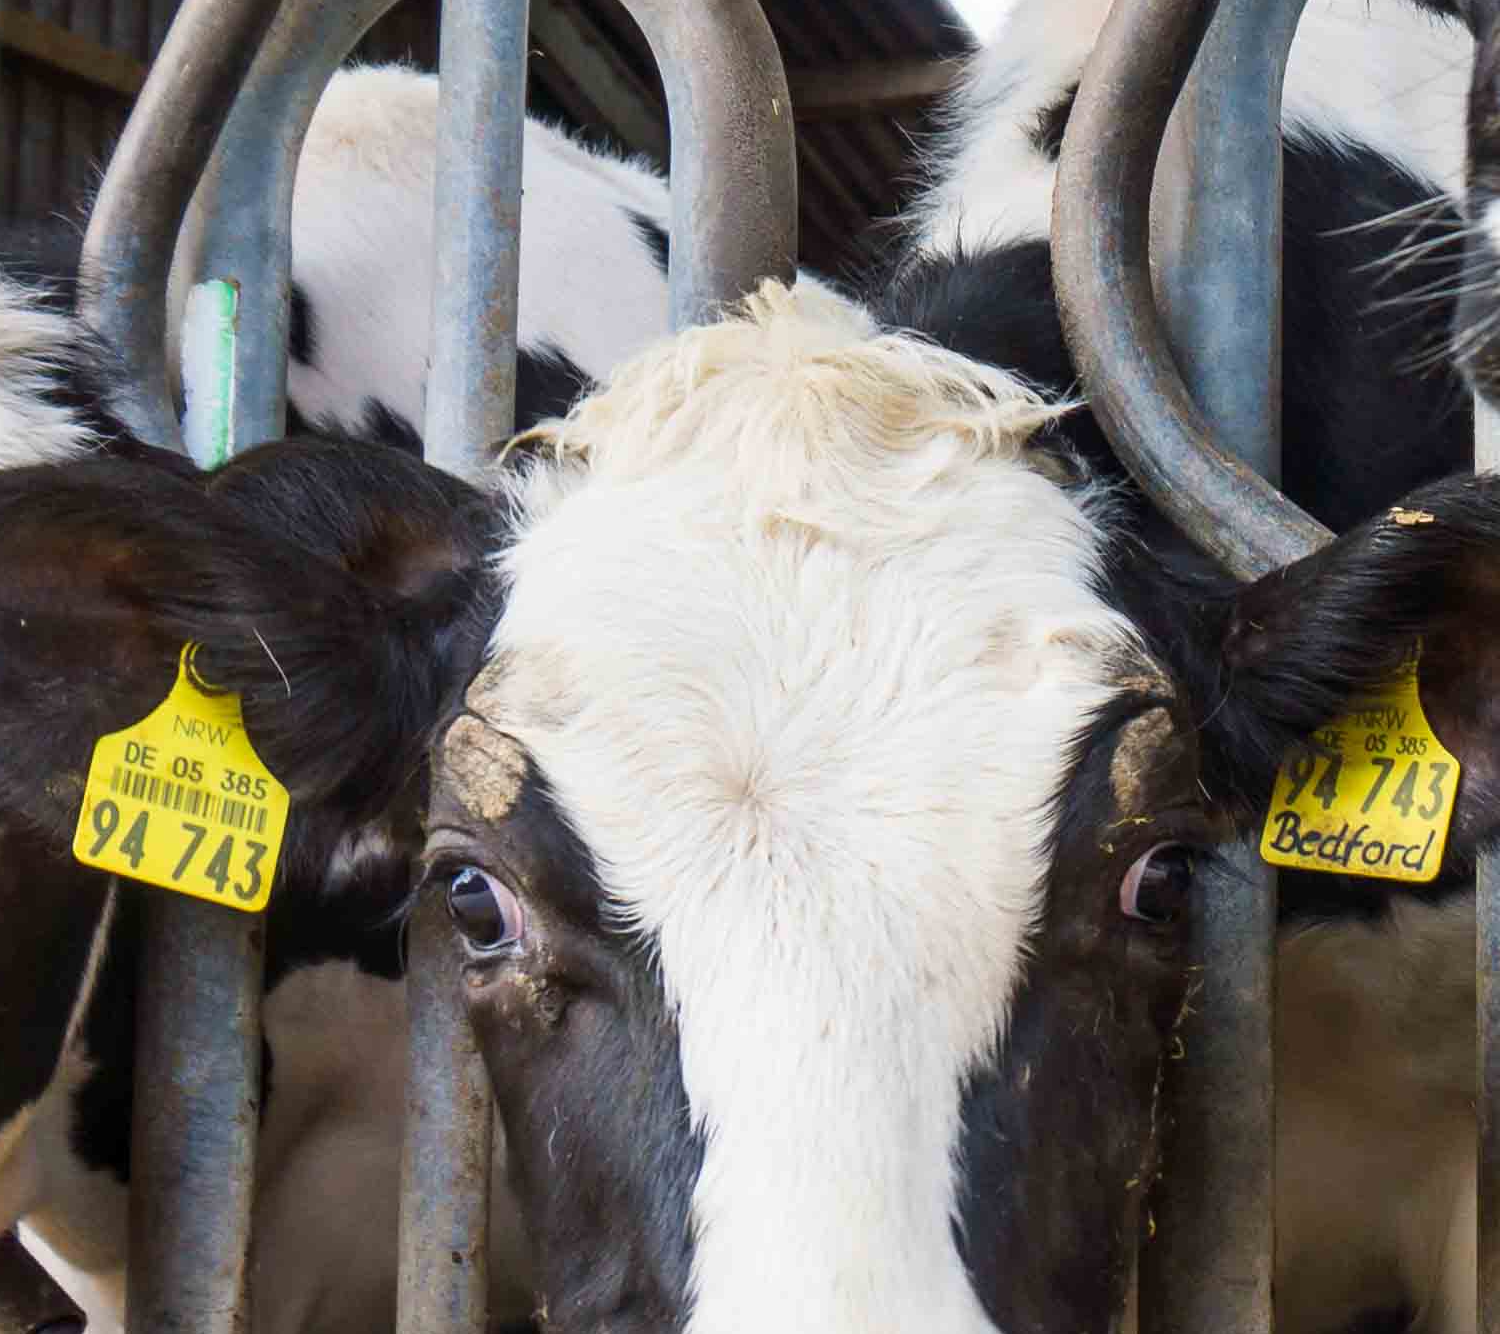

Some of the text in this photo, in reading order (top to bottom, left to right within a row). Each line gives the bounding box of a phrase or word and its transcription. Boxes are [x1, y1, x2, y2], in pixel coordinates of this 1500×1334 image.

[173, 714, 231, 748] NRW
[1364, 733, 1388, 753] 05
[1396, 736, 1428, 756] 385
[124, 740, 268, 800] DE 05 385
[1285, 754, 1450, 820] 94 743
[89, 798, 268, 901] 94 743
[1269, 811, 1436, 872] Bedford
